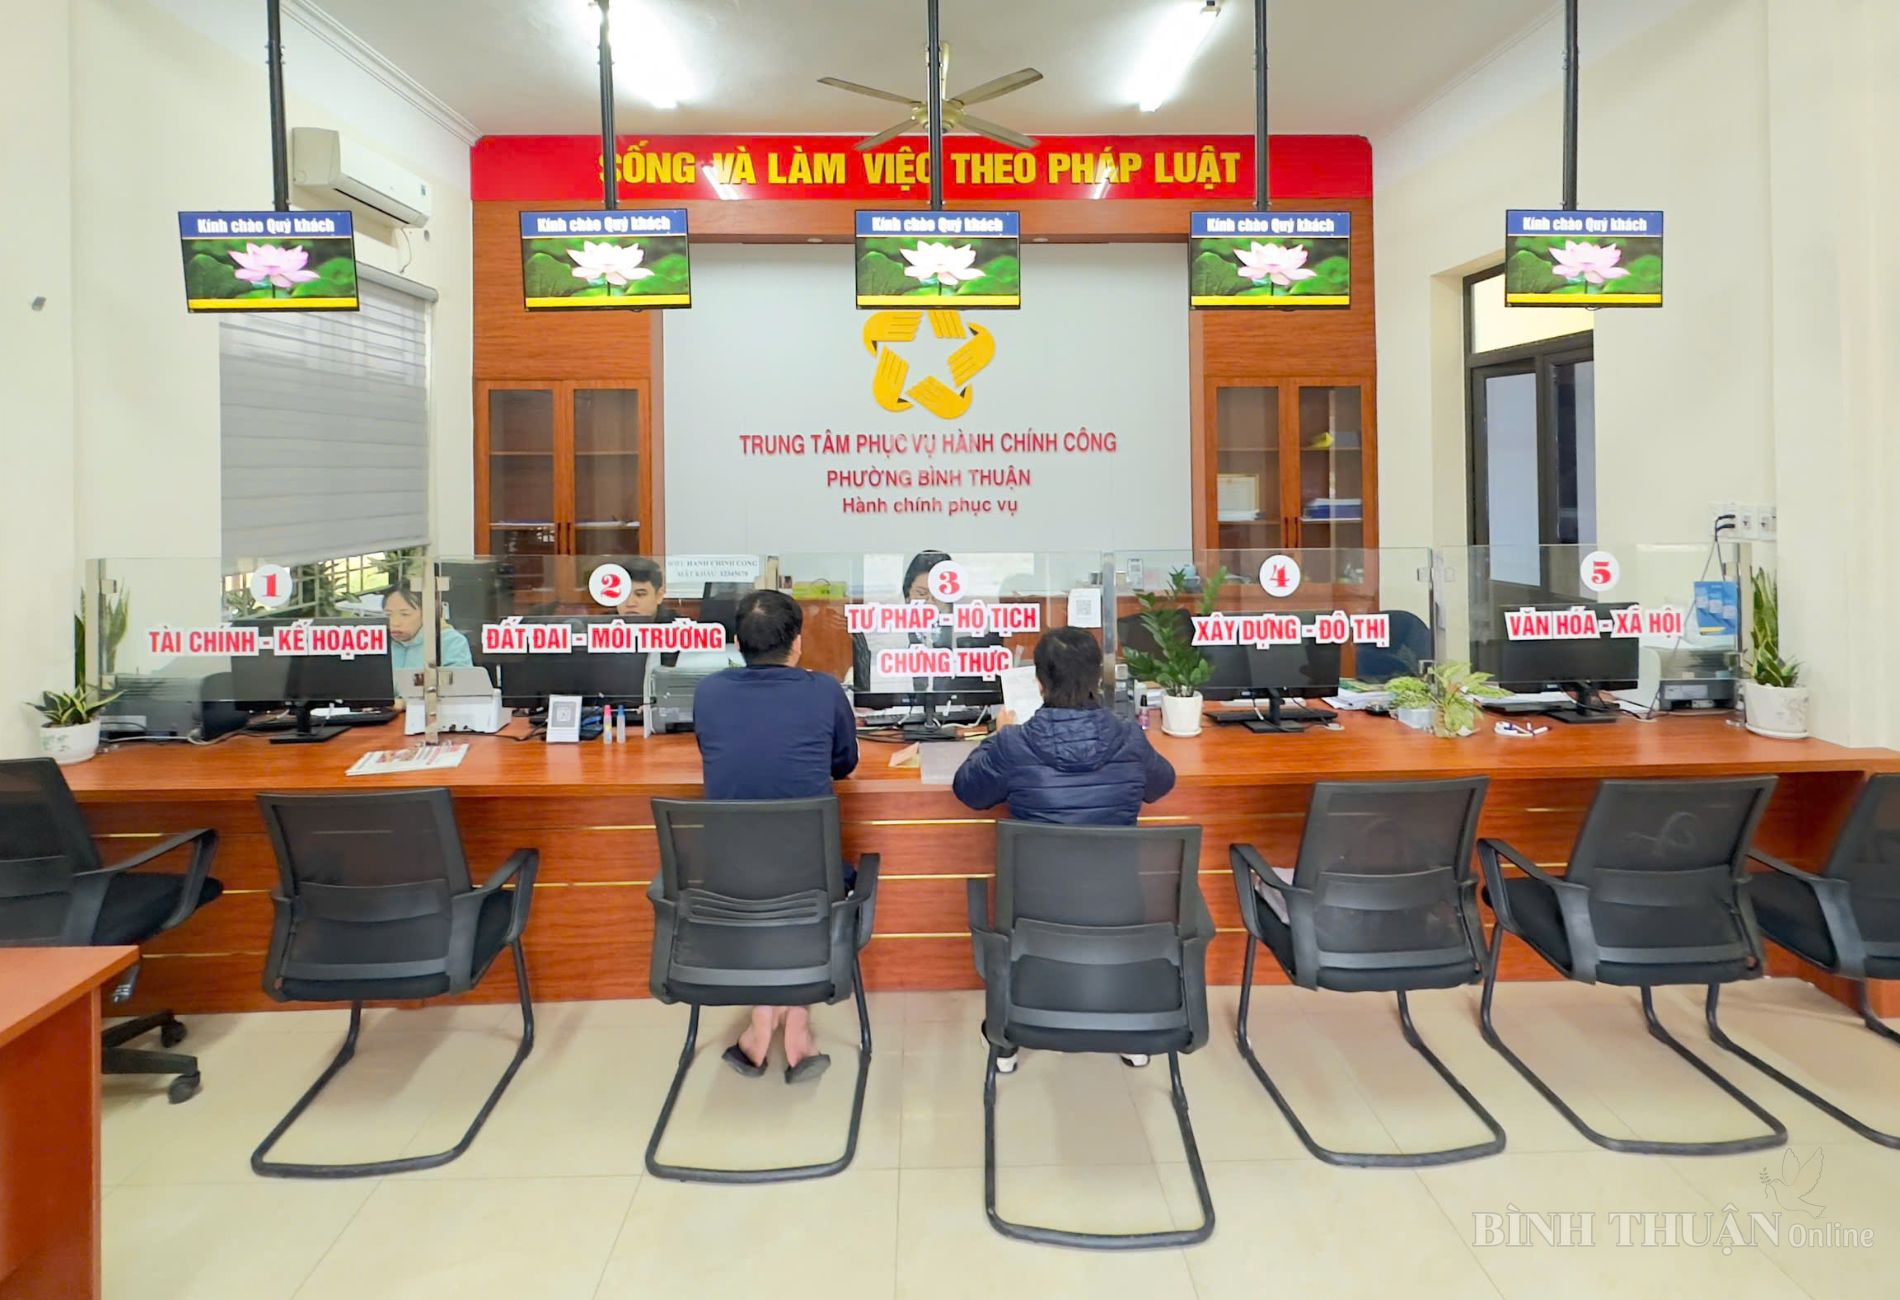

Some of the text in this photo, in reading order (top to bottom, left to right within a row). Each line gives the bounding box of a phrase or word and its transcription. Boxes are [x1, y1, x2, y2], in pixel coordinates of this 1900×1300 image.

[712, 146, 756, 184] VÀ
[768, 146, 845, 184] LÀM
[863, 146, 932, 191] VIỆC
[951, 153, 1037, 184] THEO
[1048, 146, 1142, 184] PHÁP
[1155, 146, 1240, 190] LUẬT
[197, 218, 335, 234] Kính chào Quý khách
[537, 216, 671, 232] Kính chào Quý khách
[872, 217, 1003, 233] Kính chào Quý khách
[1207, 218, 1334, 233] Kính chào Quý khách
[1523, 217, 1647, 232] Kính chào Quý khách
[739, 428, 1117, 459] TRUNG TÂM PHỤC VỤ HÀNH CHÍNH CÔNG
[827, 465, 1031, 489] PHƯỜNG BÌNH THUẬN
[842, 497, 1018, 516] Hành chính phục vụ
[939, 571, 960, 594] 3
[1270, 565, 1290, 587] 4
[1592, 561, 1611, 584] 5
[261, 573, 280, 597] 1
[601, 573, 621, 598] 2
[849, 606, 875, 630] TƯ
[881, 601, 935, 629] PHÁP
[958, 602, 985, 635] HỘ
[991, 607, 1036, 635] TỊCH
[1197, 614, 1235, 640] XÂY
[1243, 617, 1297, 647] DỰNG
[1319, 612, 1345, 640] ĐÔ
[1354, 618, 1385, 647] THỊ
[1510, 610, 1549, 636] VĂN
[1557, 608, 1596, 635] HÓA
[1616, 608, 1642, 633] XÃ
[1649, 608, 1681, 638] HỘI
[149, 625, 181, 652] TÀI
[189, 625, 255, 652] CHÍNH
[279, 620, 307, 650] KẾ
[313, 629, 384, 656] HOẠCH
[486, 618, 525, 649] ĐẤT
[533, 627, 570, 648] ĐAI
[592, 622, 631, 648] MÔI
[638, 620, 722, 649] TRƯỜNG
[881, 647, 1009, 678] CHỨNG THỰC
